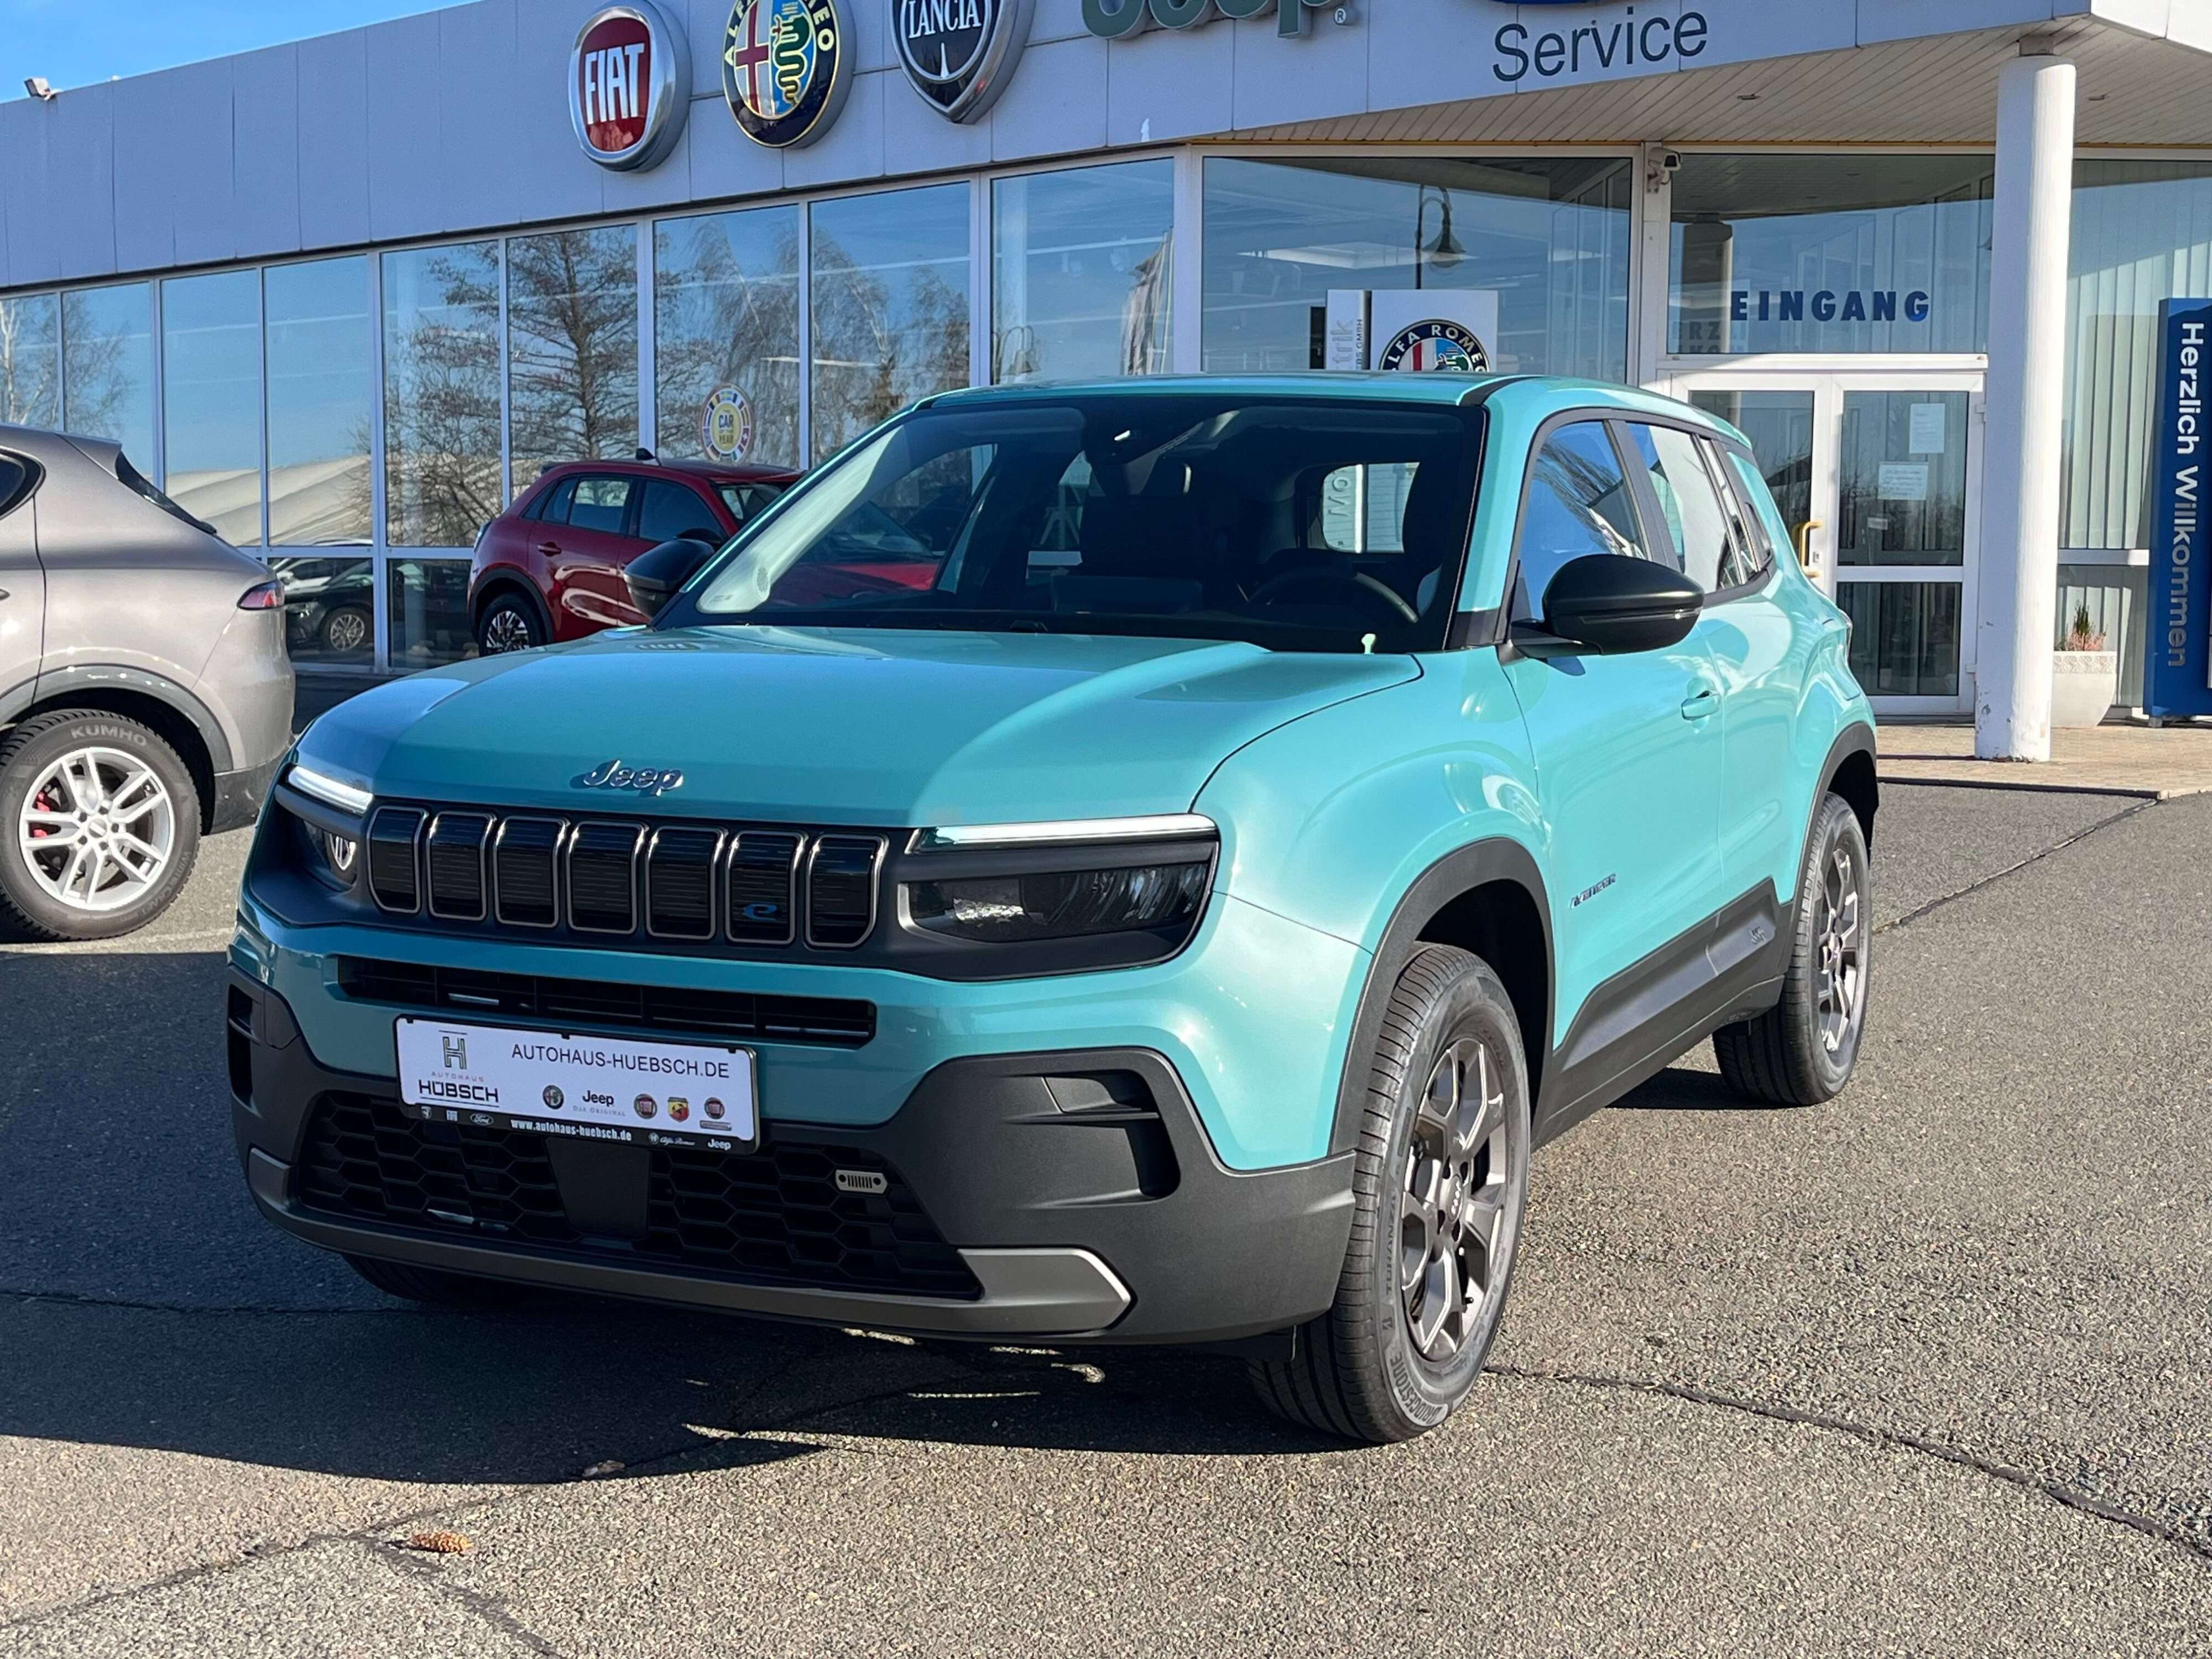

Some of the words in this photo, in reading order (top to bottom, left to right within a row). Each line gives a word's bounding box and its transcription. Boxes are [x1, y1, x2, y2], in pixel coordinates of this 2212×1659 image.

[724, 0, 752, 66] ALF
[909, 0, 982, 38] LANCIA
[1493, 6, 1708, 82] Service
[585, 43, 645, 125] FIAT
[1730, 290, 1929, 321] EINGANG
[1387, 331, 1421, 371] LFA
[2176, 322, 2204, 455] Herzlich
[719, 415, 734, 428] CAR
[2168, 465, 2199, 667] Willkommen
[71, 725, 147, 746] KUMHO
[583, 760, 684, 796] Jeep
[431, 1071, 484, 1082] AUTOHAUS
[512, 1043, 730, 1078] AUTOHAUS-HUEBSCH.DE
[418, 1079, 499, 1103] HÜBSCH
[582, 1090, 614, 1107] Jeep
[510, 1119, 632, 1141] www.autohaus-huebsch.de
[707, 1138, 732, 1151] Jeep
[1389, 1350, 1443, 1425] BRIDGESTONE
